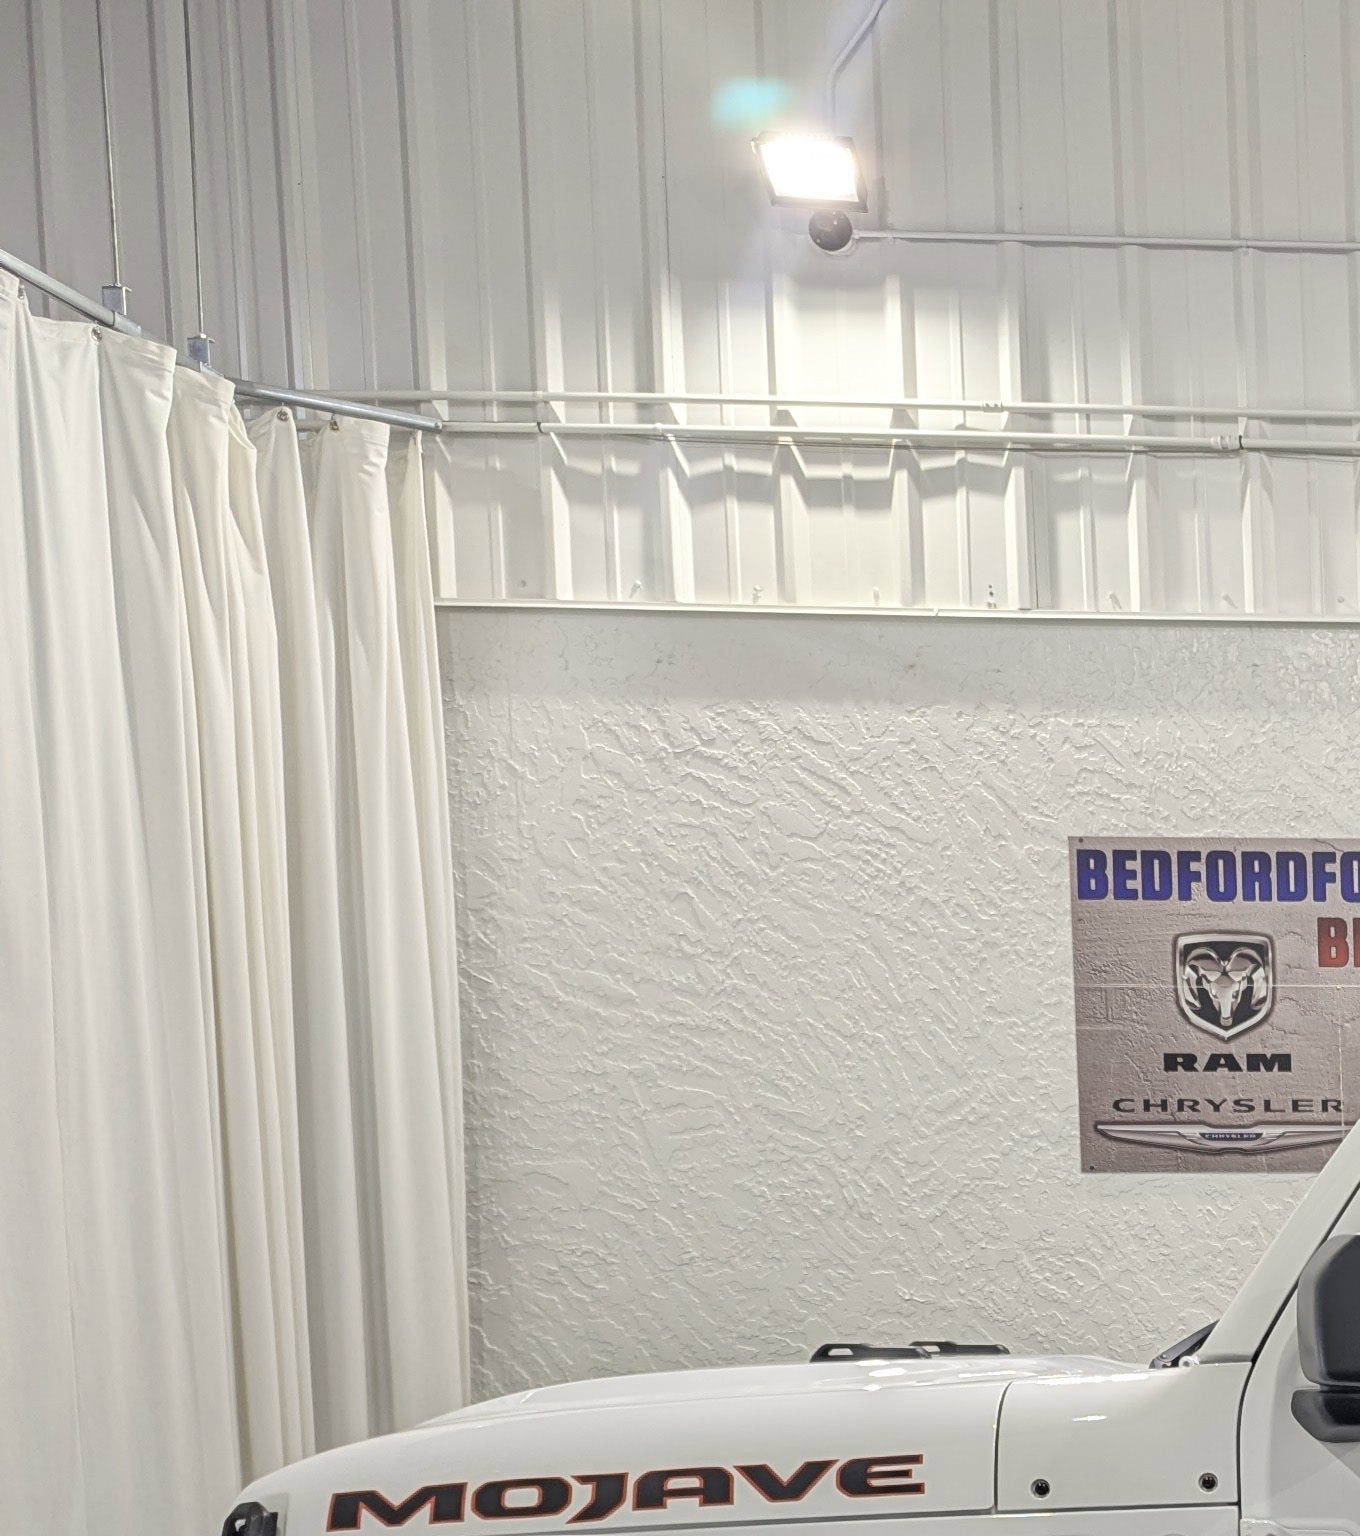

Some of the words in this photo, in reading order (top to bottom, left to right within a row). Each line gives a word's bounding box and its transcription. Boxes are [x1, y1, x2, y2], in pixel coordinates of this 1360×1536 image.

[1163, 1053, 1292, 1073] RAM
[1112, 1098, 1345, 1113] CHRYSLER
[326, 1453, 925, 1533] MOJAVE
